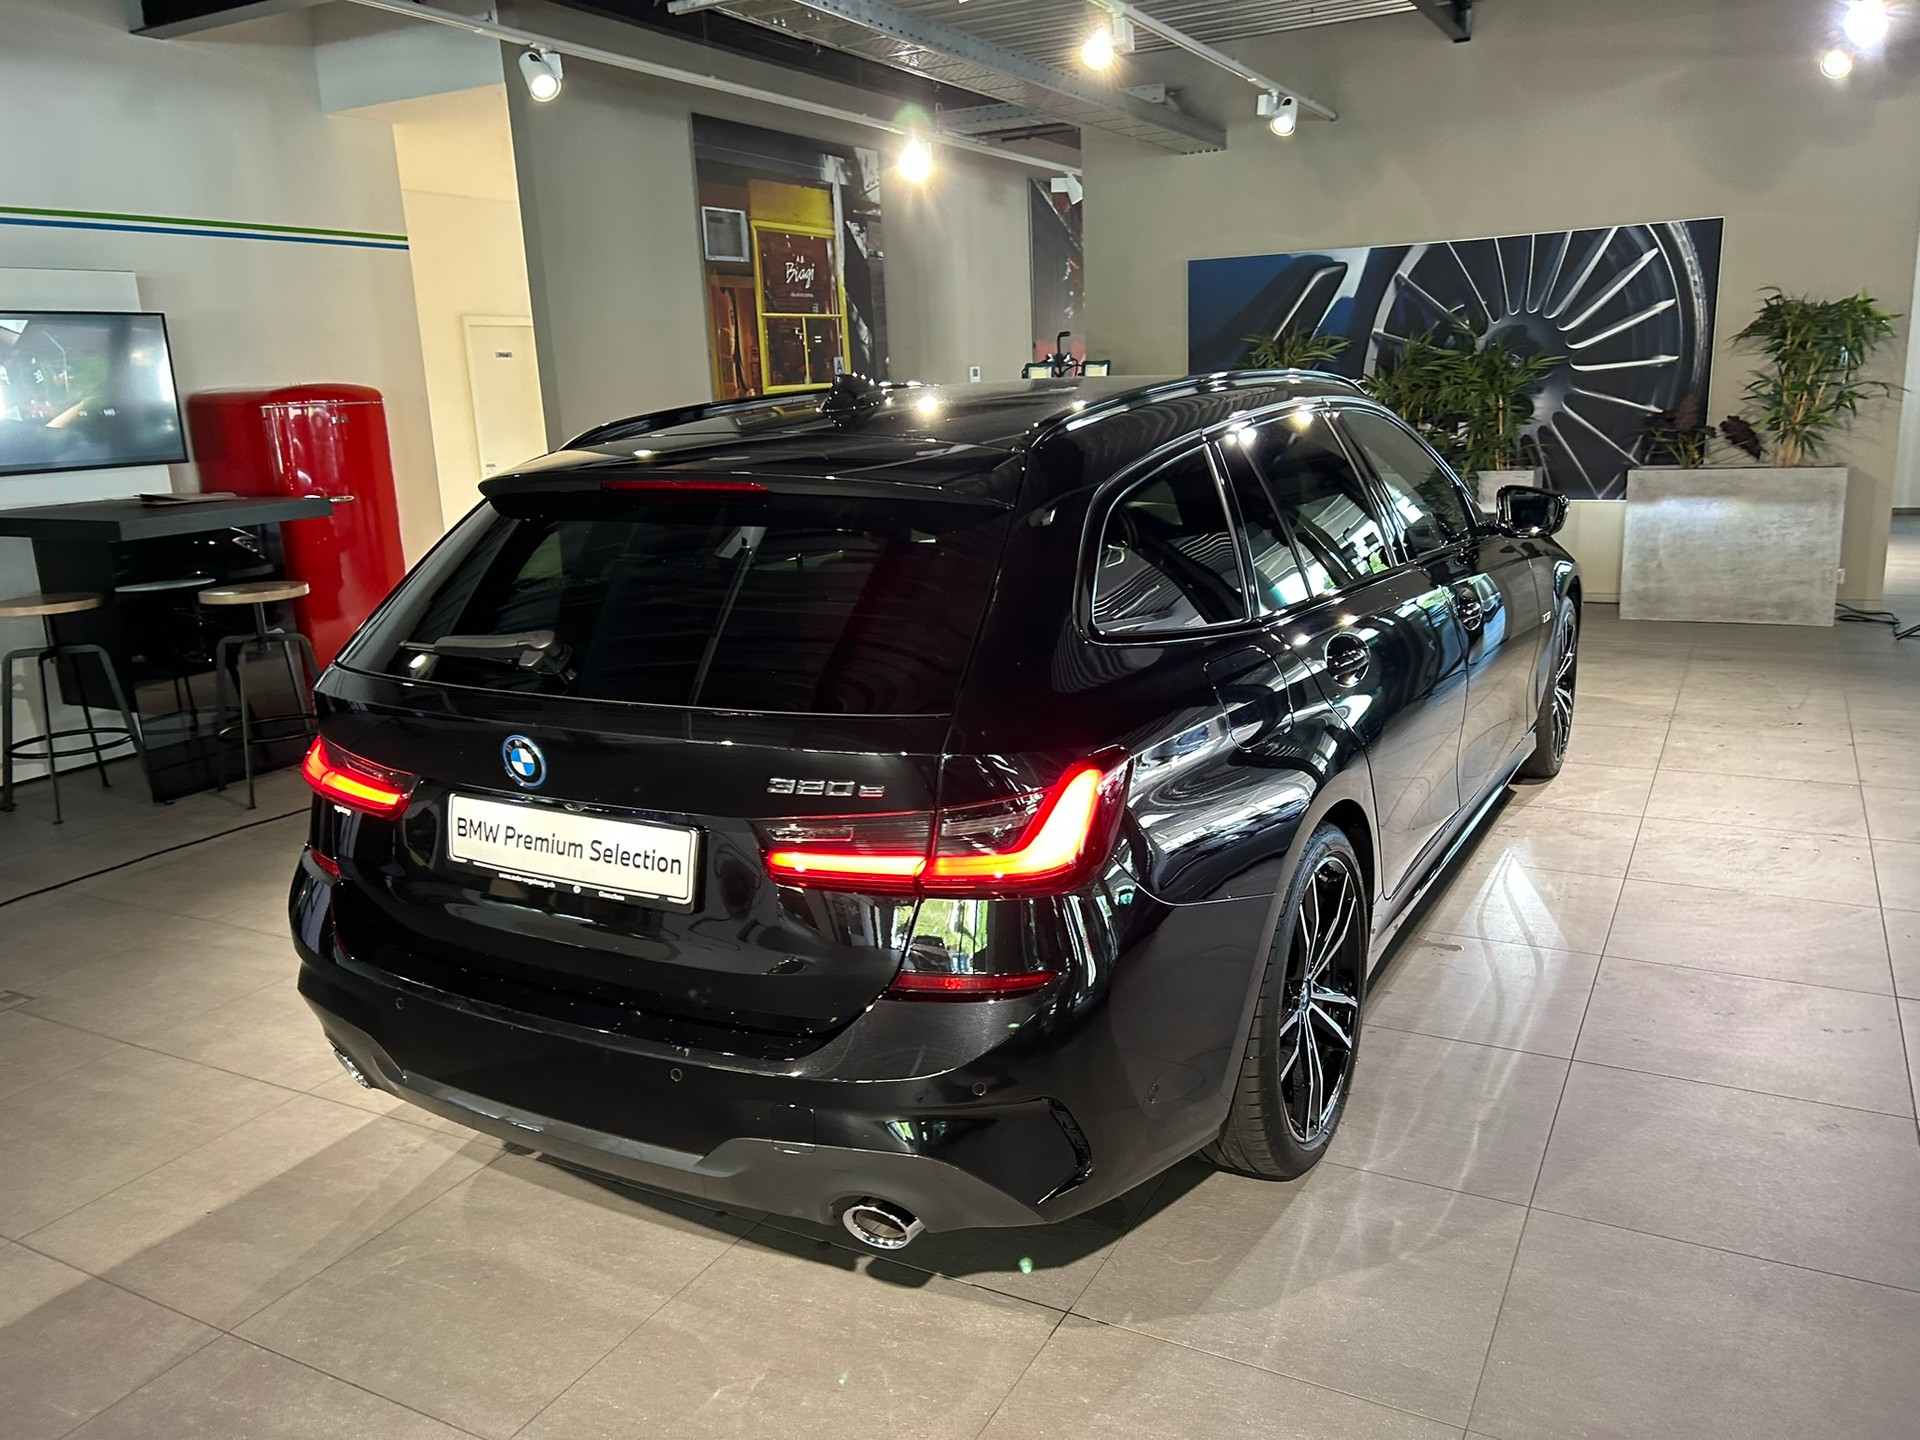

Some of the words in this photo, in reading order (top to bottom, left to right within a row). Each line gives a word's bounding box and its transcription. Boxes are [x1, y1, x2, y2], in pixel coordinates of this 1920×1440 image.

[456, 817, 500, 844] BMW
[504, 825, 584, 860] Premium
[589, 839, 682, 876] Selection
